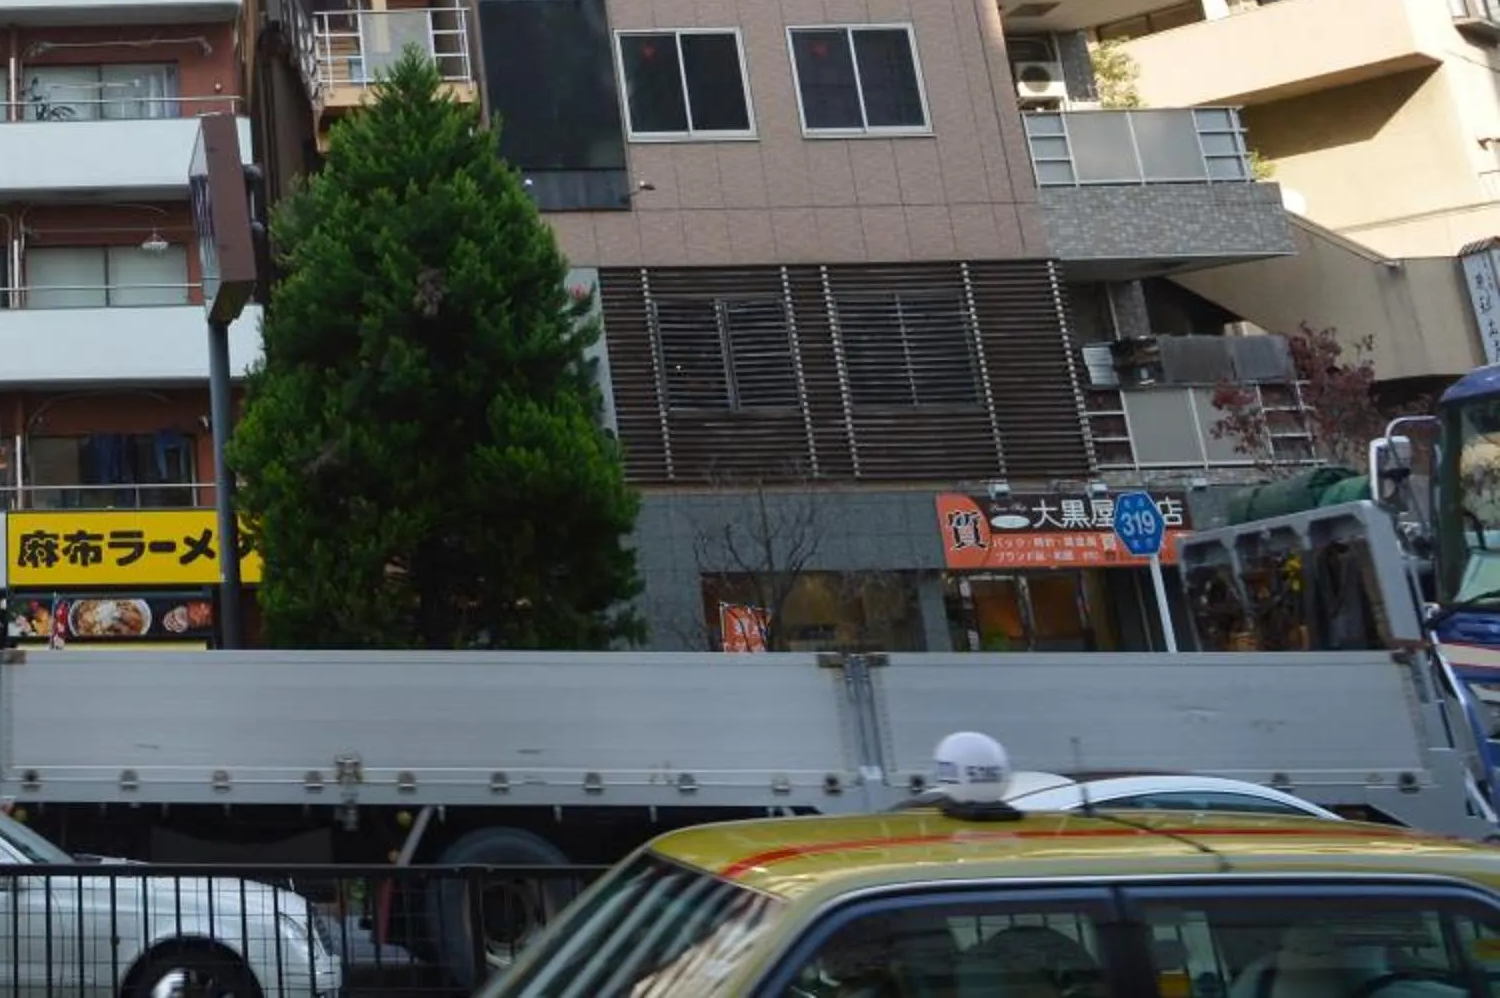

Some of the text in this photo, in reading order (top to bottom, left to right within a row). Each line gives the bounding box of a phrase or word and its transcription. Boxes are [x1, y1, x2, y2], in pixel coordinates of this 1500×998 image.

[1120, 510, 1156, 536] 319
[17, 528, 217, 569] 麻布ラーメ
